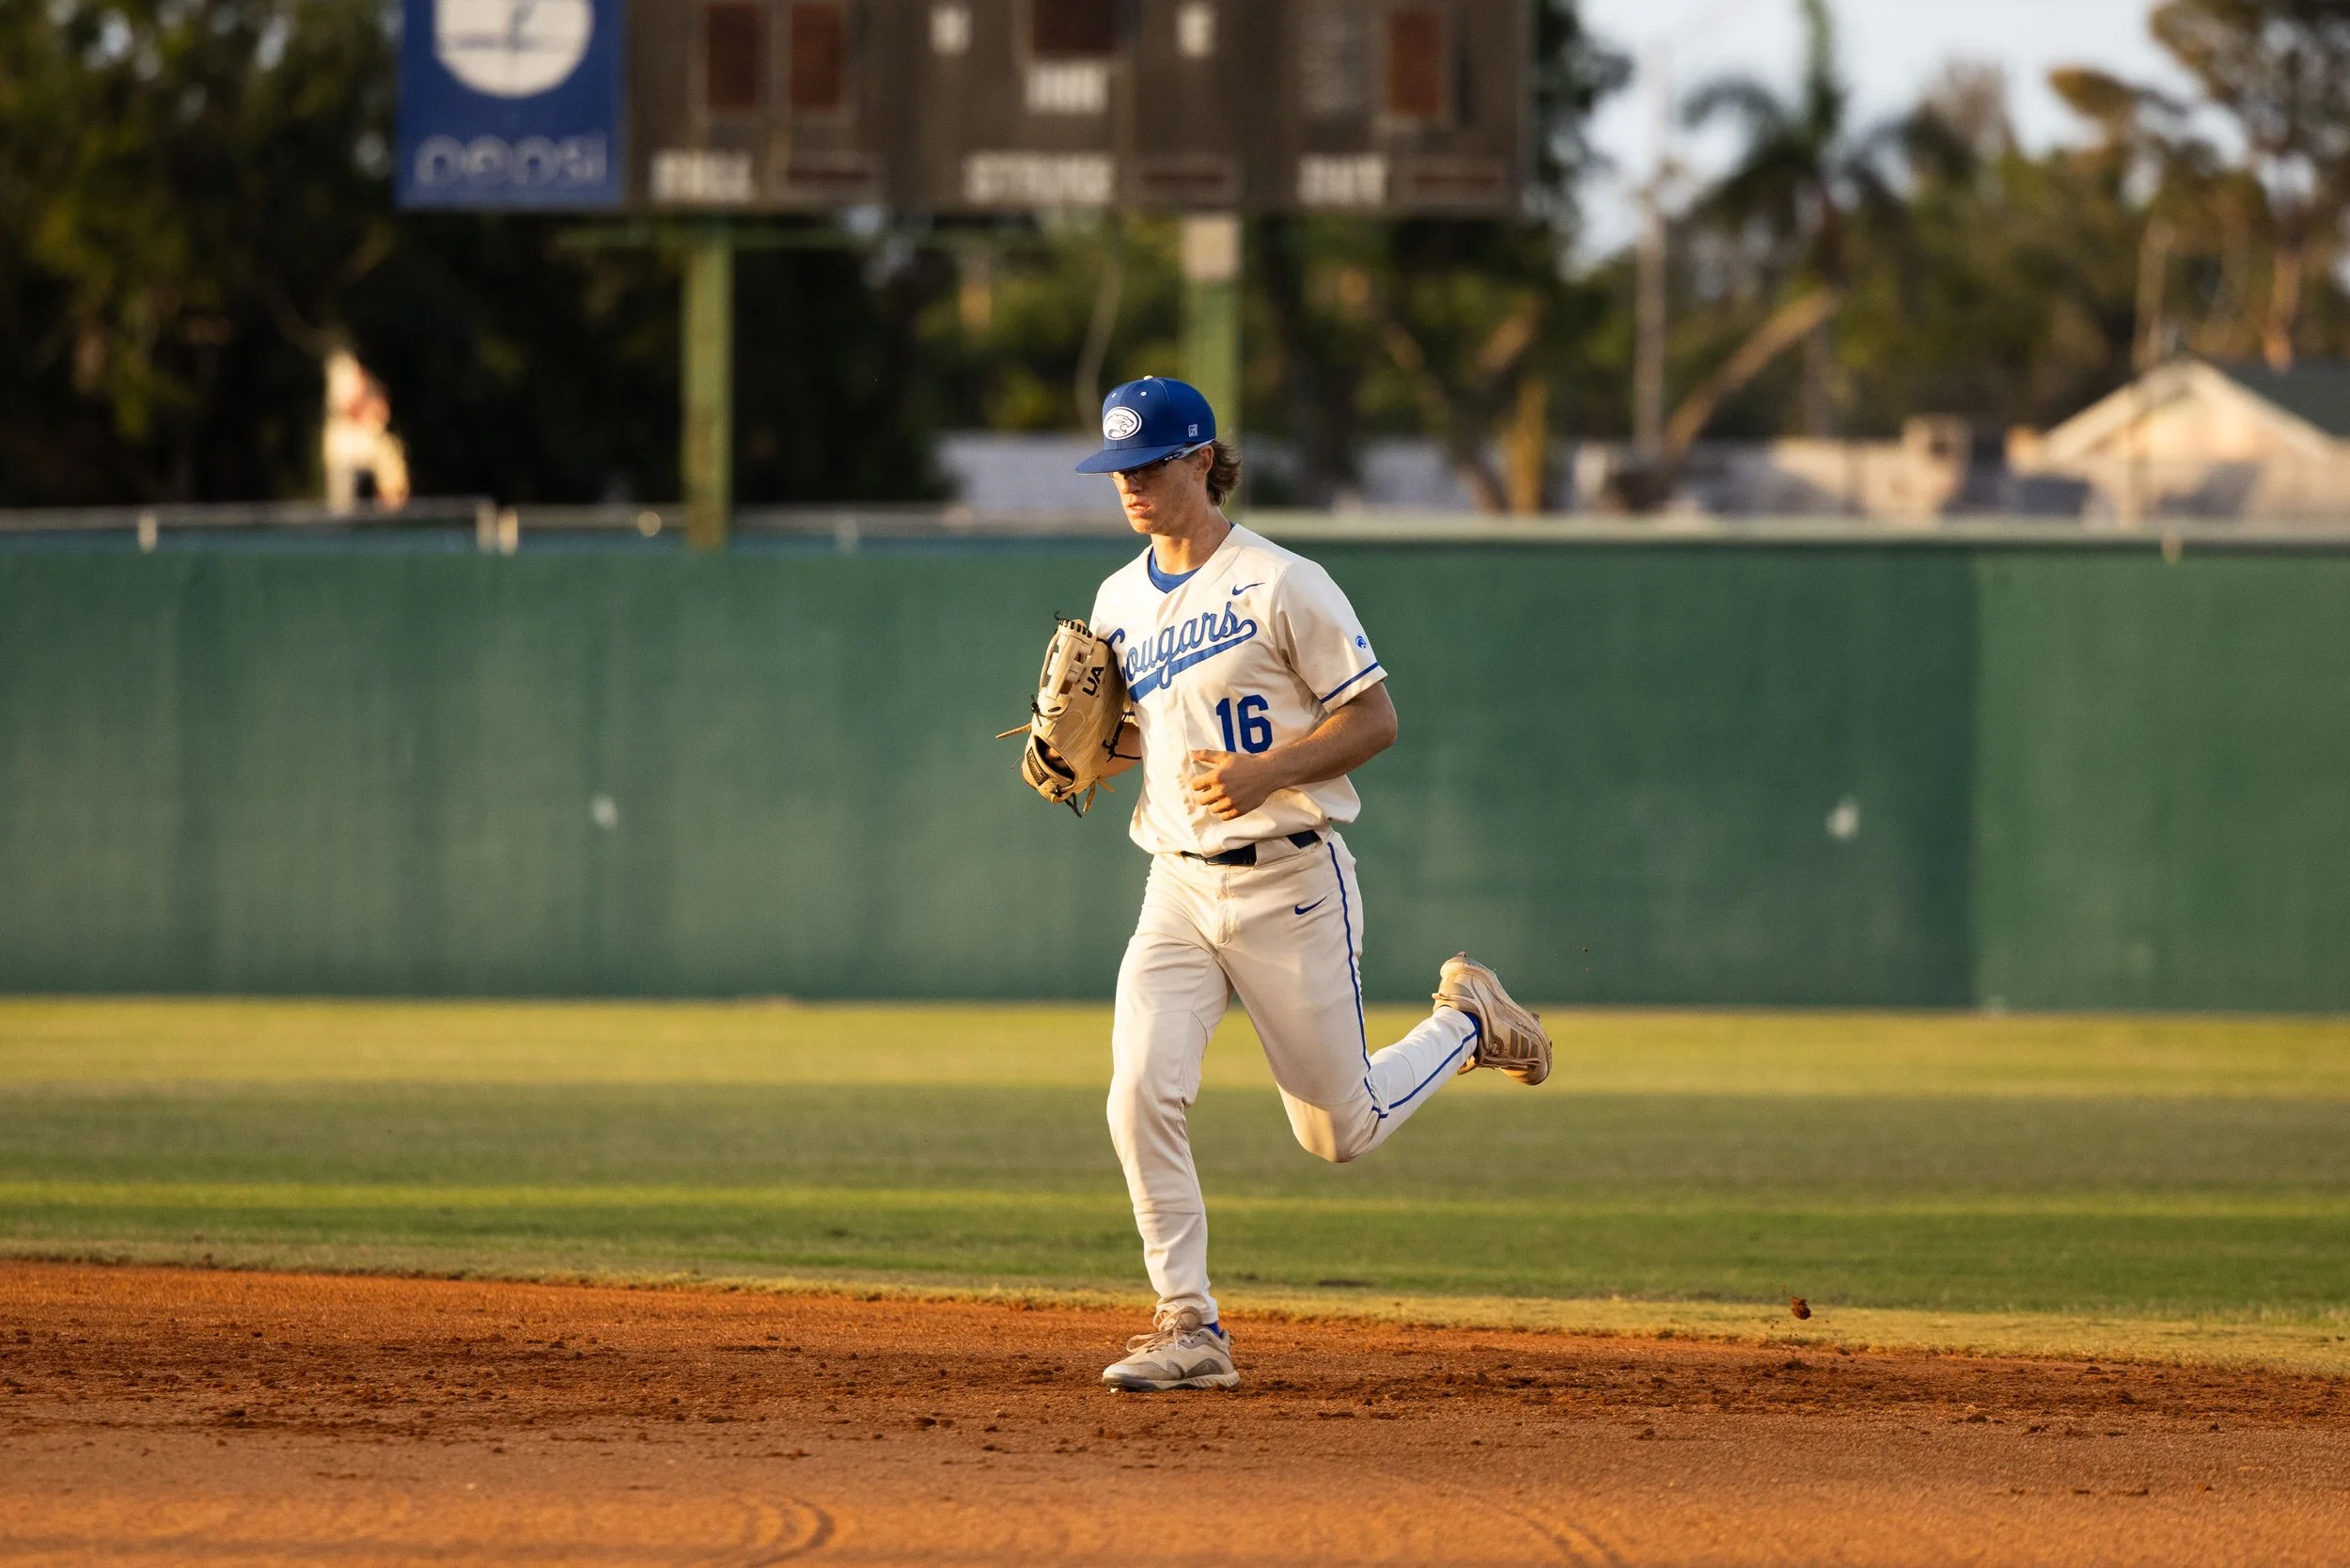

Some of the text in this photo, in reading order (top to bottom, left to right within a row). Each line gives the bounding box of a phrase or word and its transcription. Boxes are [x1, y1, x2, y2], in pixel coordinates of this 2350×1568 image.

[415, 129, 608, 188] pepsi
[1083, 666, 1104, 696] UA
[1216, 694, 1273, 754] 16
